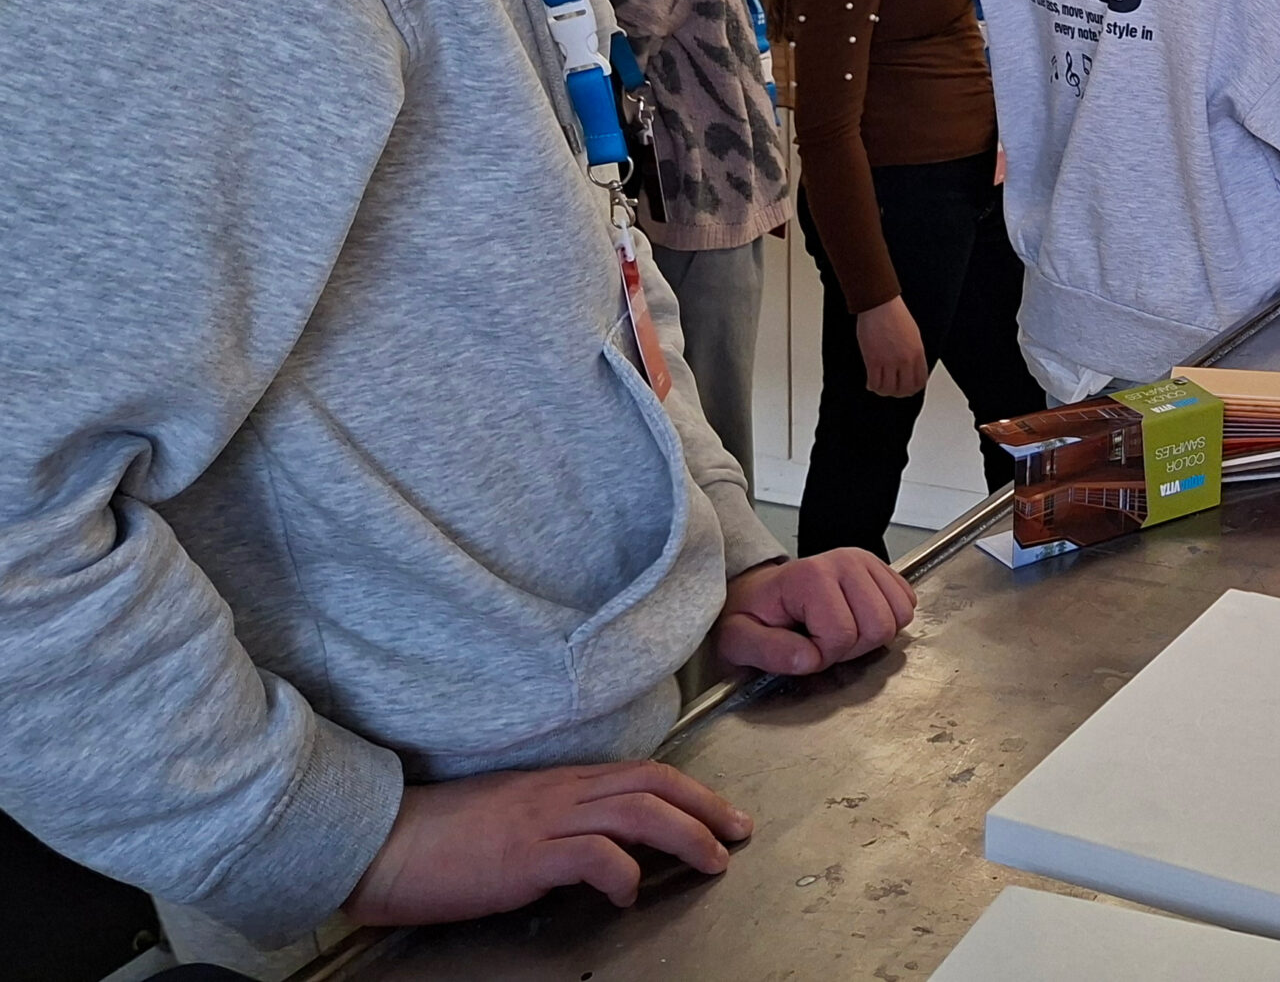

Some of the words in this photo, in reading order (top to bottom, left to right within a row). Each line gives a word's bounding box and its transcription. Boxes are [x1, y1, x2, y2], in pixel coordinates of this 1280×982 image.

[1054, 21, 1075, 40] every
[1061, 4, 1083, 19] move
[1085, 10, 1104, 25] your
[1106, 21, 1138, 39] style
[1141, 25, 1153, 41] in
[1154, 436, 1206, 460] SAMPLES
[1166, 452, 1205, 473] COLOR
